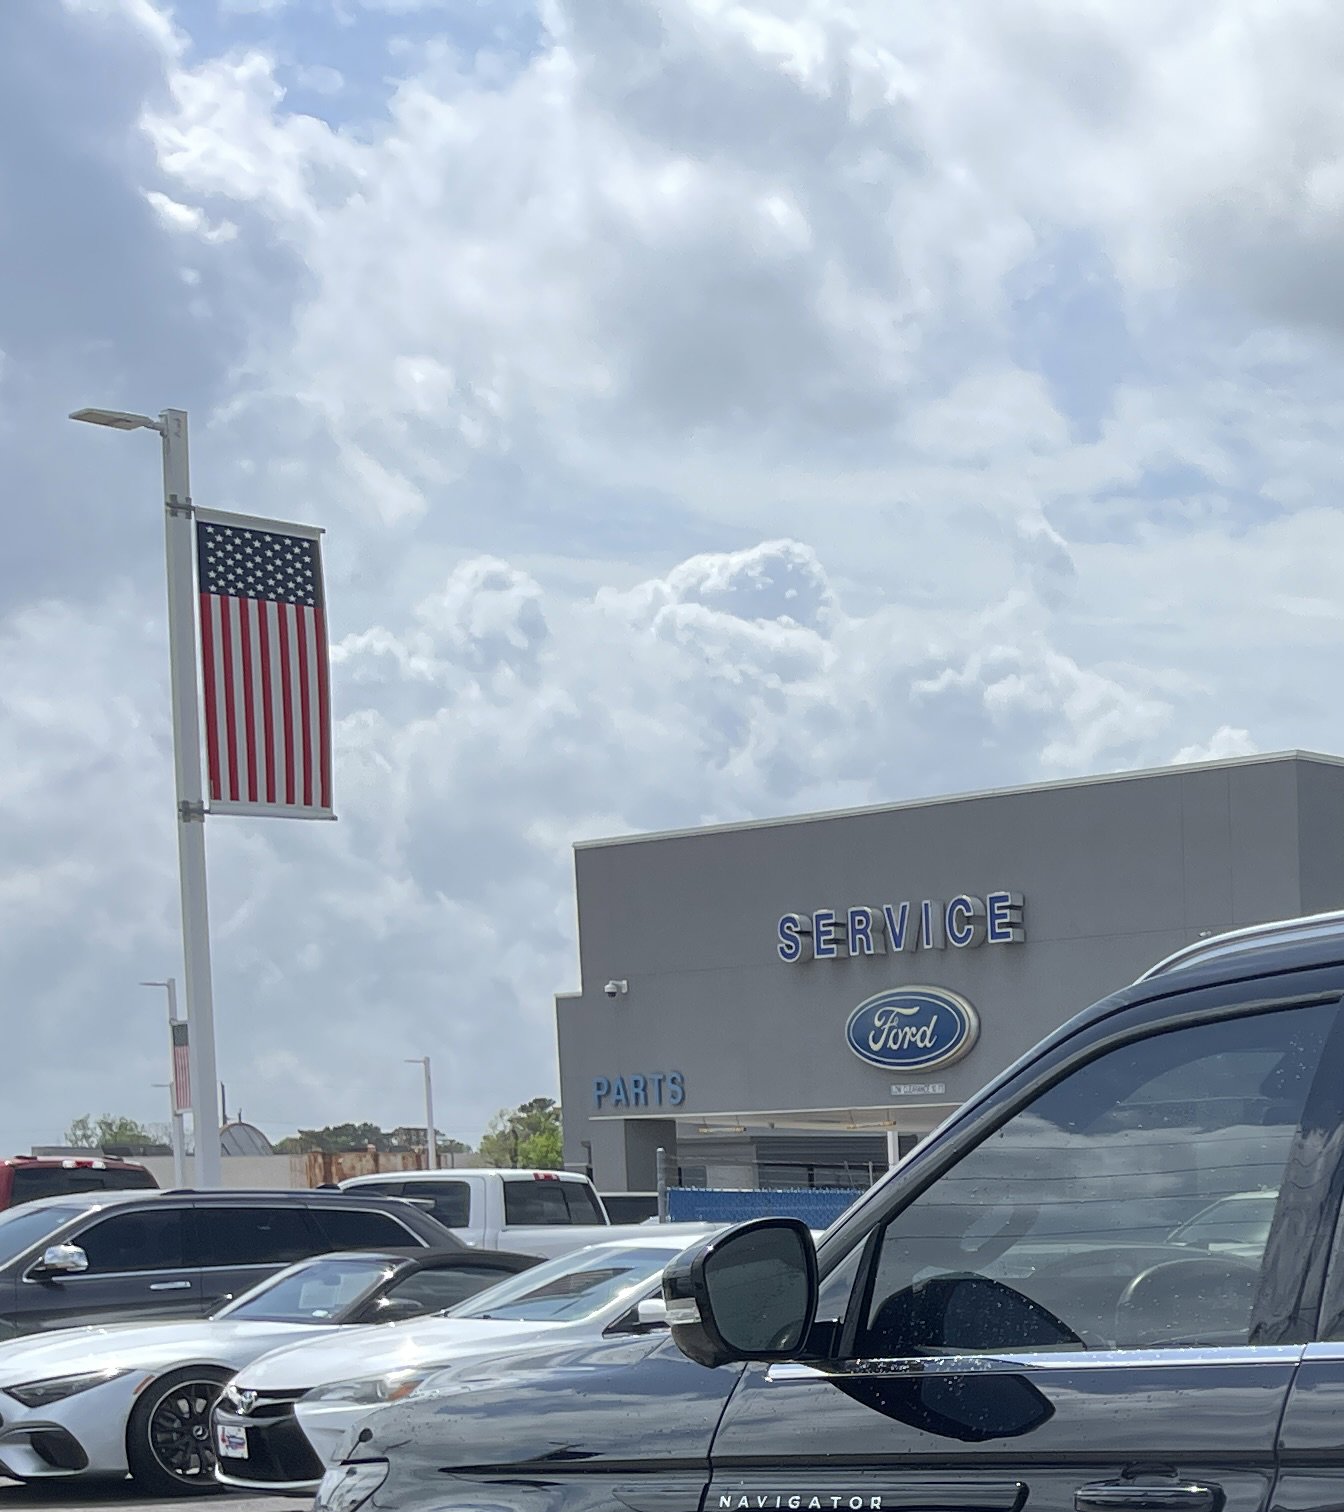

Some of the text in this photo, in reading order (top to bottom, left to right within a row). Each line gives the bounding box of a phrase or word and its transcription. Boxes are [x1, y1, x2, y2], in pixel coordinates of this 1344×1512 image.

[778, 892, 1024, 963] SERVICE
[868, 1006, 938, 1051] Ford
[592, 1071, 686, 1109] PARTS
[719, 1495, 881, 1510] NAVIGATOR
